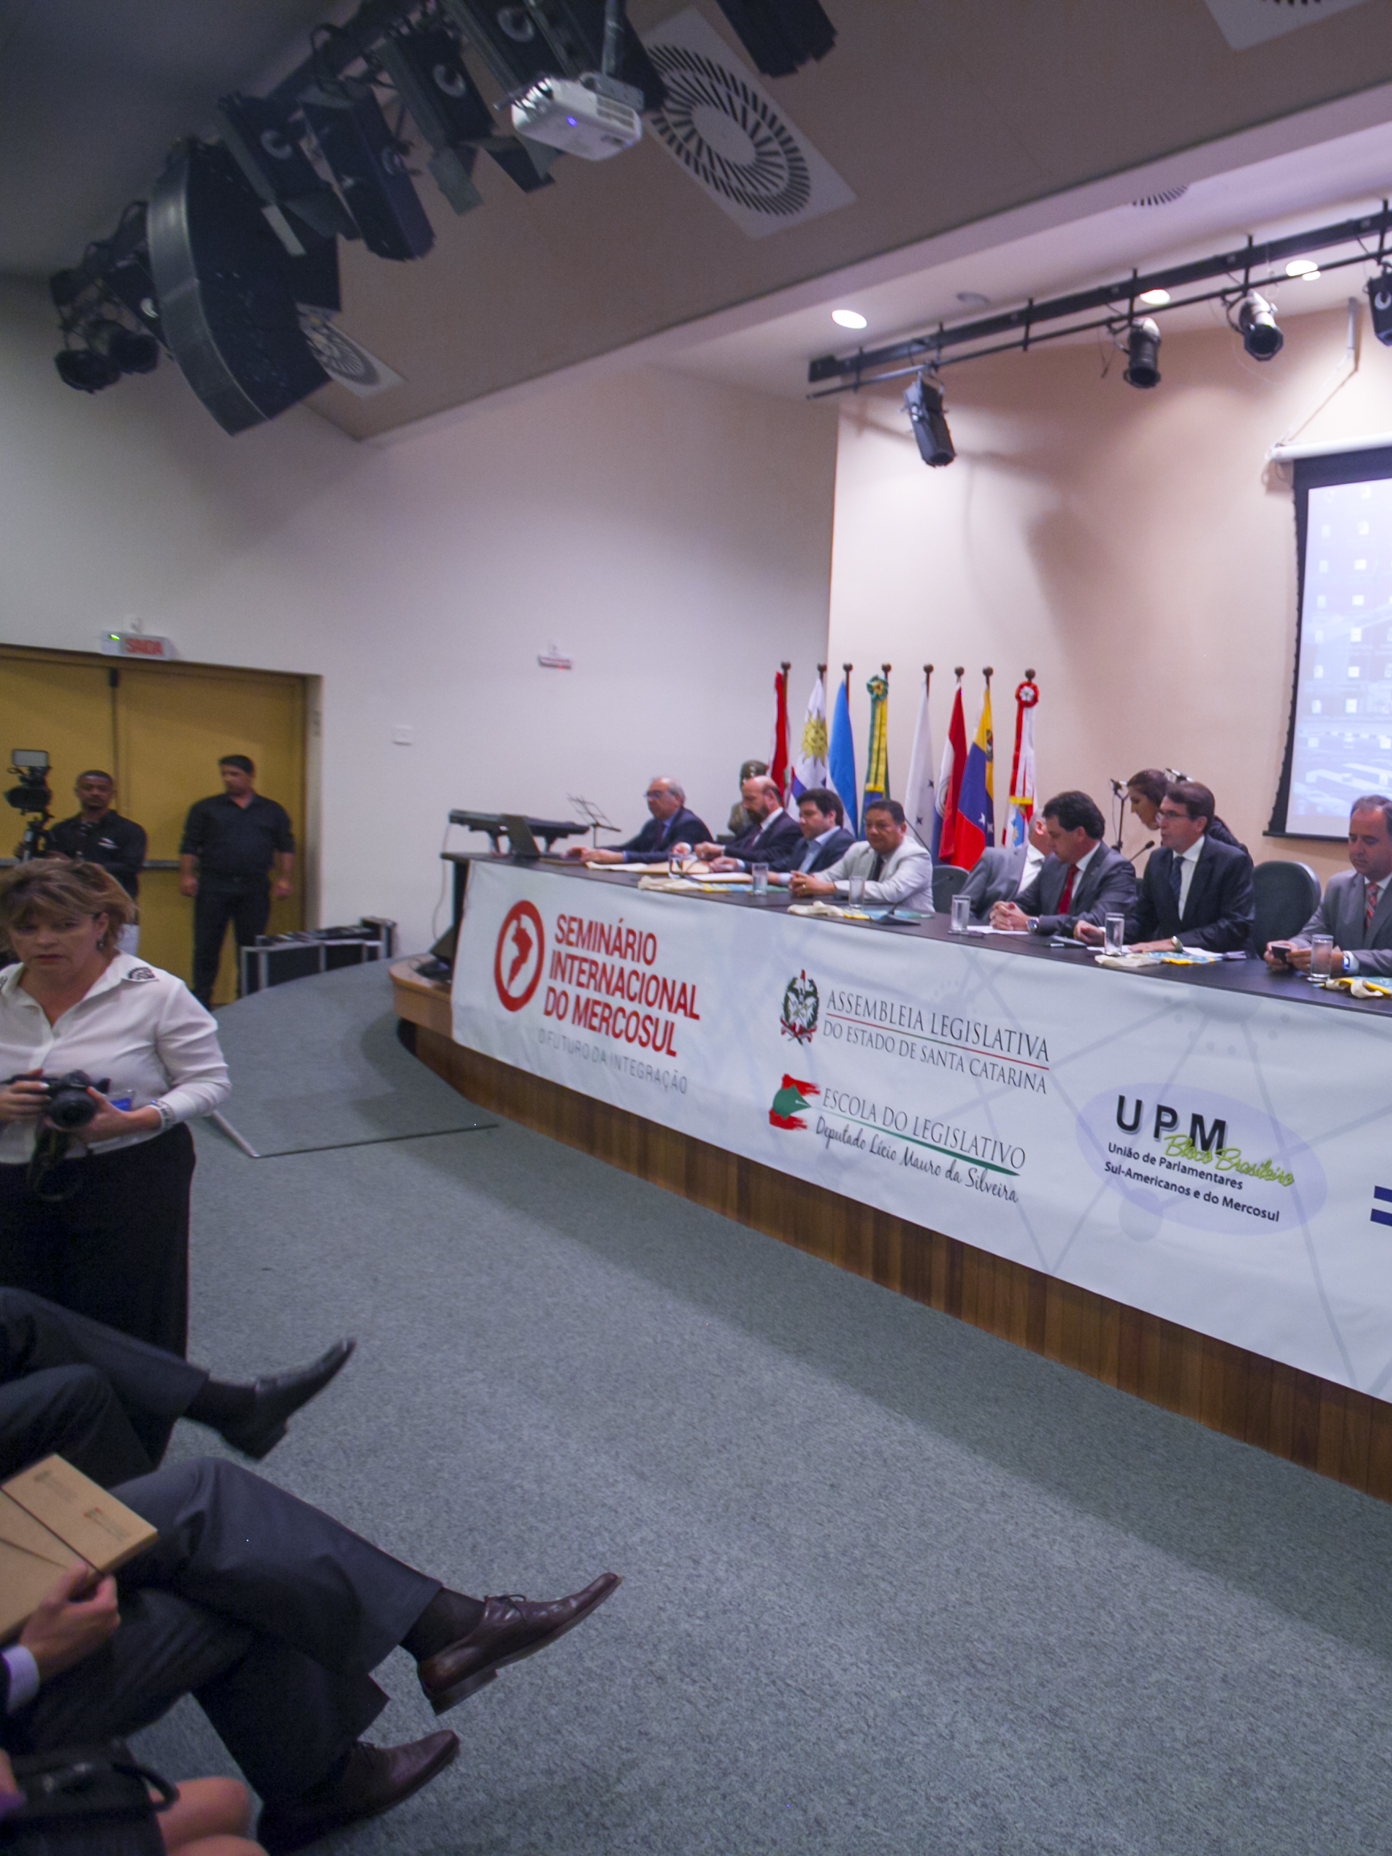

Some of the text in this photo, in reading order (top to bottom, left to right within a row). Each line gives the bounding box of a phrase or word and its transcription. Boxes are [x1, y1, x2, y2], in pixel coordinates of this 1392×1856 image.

[554, 913, 658, 967] SEMINÁRIO
[549, 950, 700, 1021] INTERNACIONAL
[543, 985, 677, 1058] DO MERCOSUL
[826, 989, 1050, 1063] ASSEMBLEIA LEGISLATIVA
[546, 1031, 590, 1060] FUTURO
[591, 1046, 608, 1065] DA
[609, 1052, 688, 1095] INTEGRAÇÃO
[822, 1020, 1047, 1095] DO ESTADO DE SANTA CATARINA
[815, 1115, 866, 1150] Deputado
[899, 1146, 942, 1177] Mauro
[945, 1158, 962, 1185] da
[965, 1167, 1019, 1204] Silveira
[822, 1087, 1026, 1170] ESCOLA DO LEGISLATIVO
[1163, 1134, 1295, 1187] Bloco Brasileiro
[1104, 1161, 1280, 1223] Sul-Americanos e do Mercosul
[1107, 1142, 1244, 1190] União de Parlamentares
